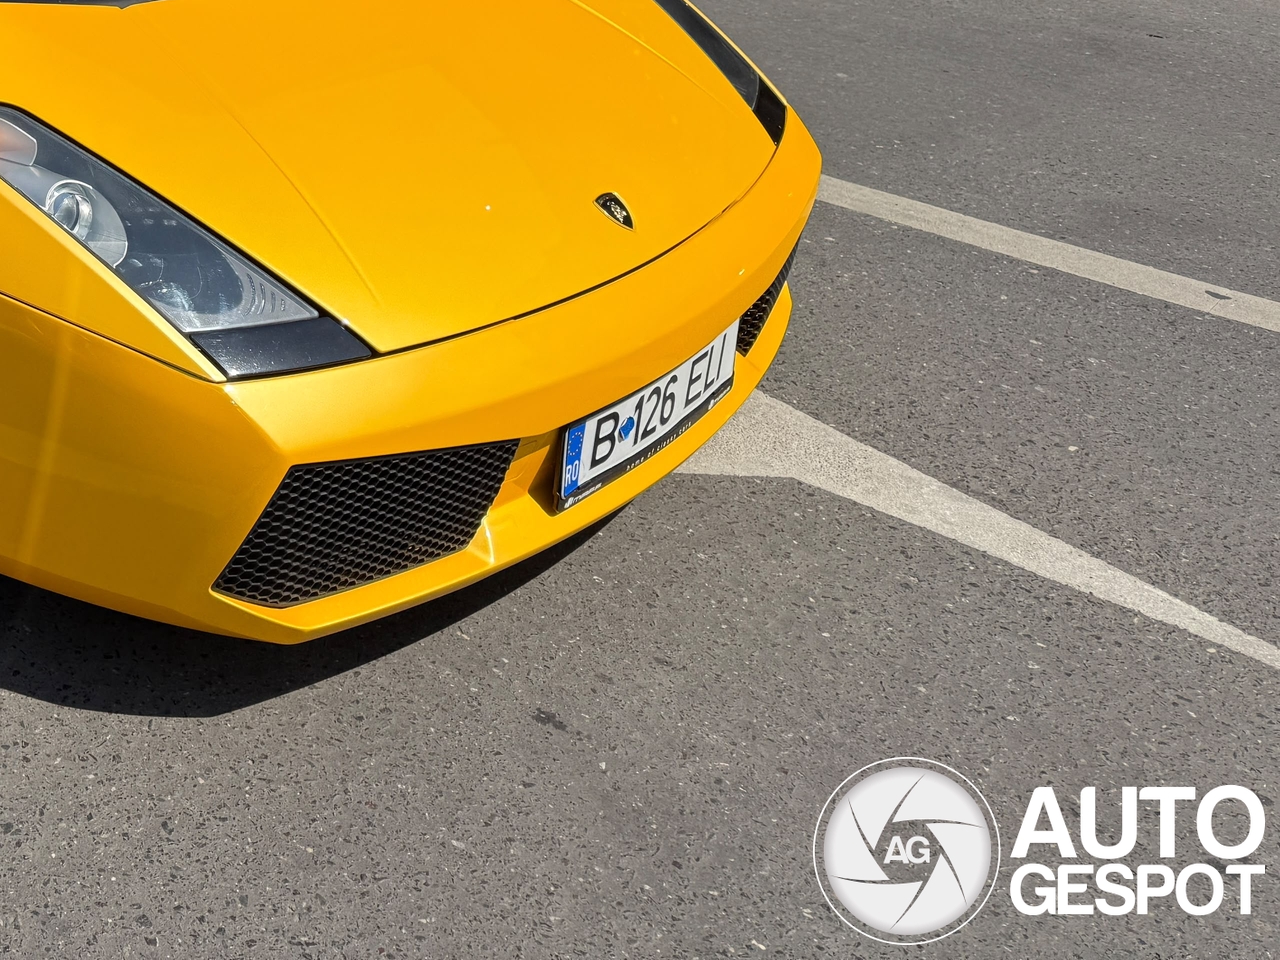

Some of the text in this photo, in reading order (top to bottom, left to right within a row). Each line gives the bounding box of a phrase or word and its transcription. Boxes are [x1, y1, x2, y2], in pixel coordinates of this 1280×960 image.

[564, 459, 579, 487] RO
[589, 411, 620, 471] B
[632, 374, 678, 447] 126
[683, 332, 727, 409] ELI
